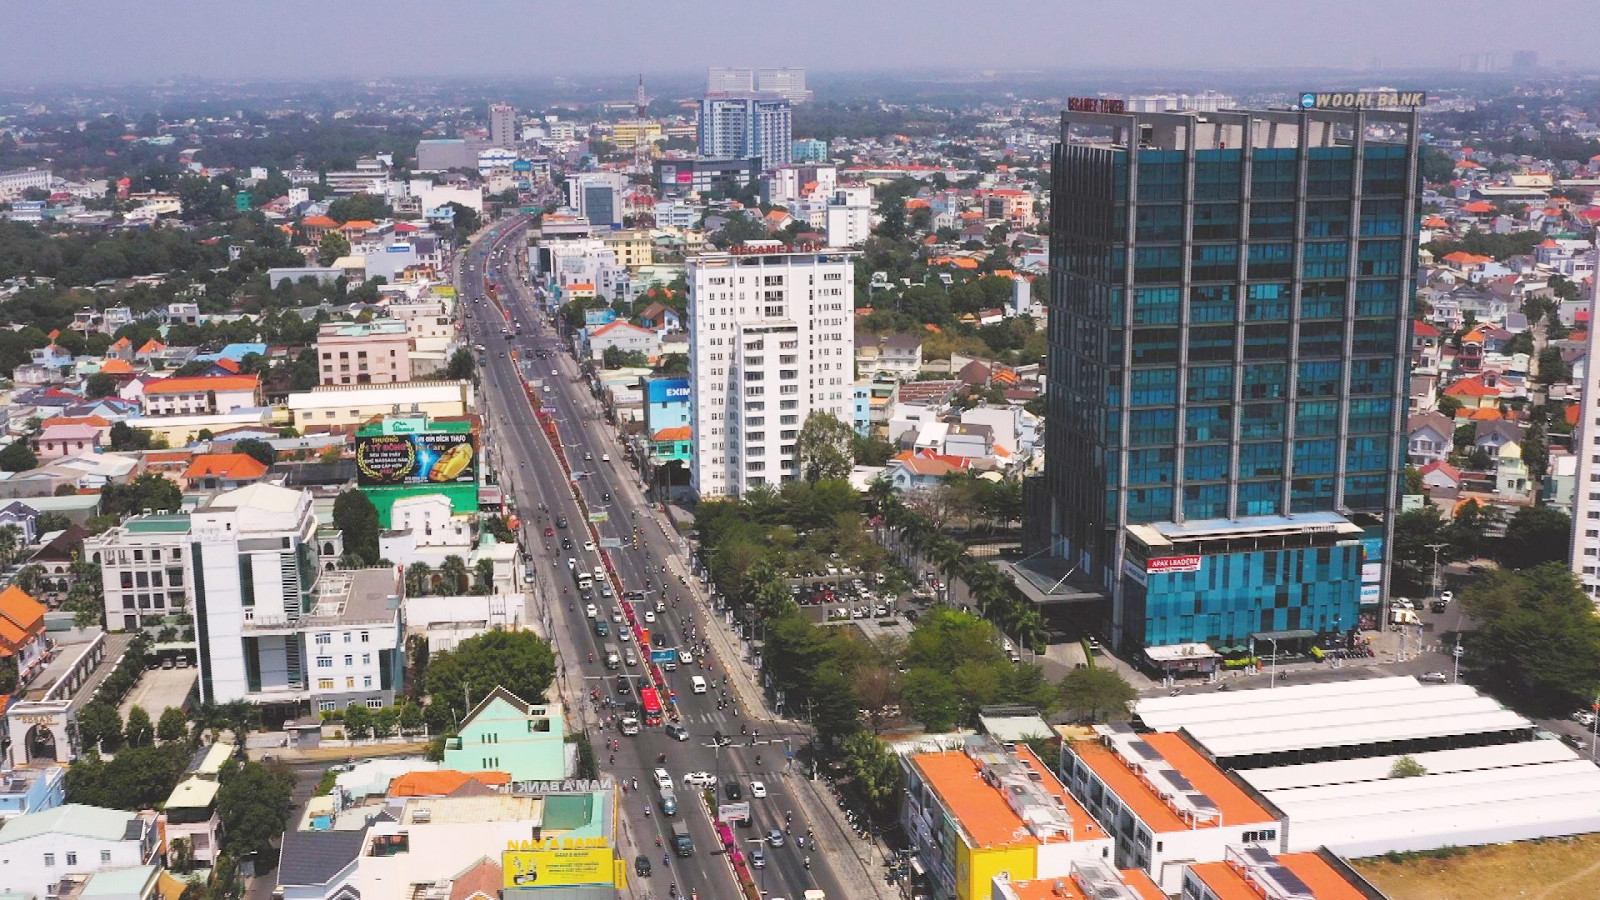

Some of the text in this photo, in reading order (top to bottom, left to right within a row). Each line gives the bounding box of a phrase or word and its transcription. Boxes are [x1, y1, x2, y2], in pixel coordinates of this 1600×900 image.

[1316, 92, 1423, 107] WOORI BANK
[729, 244, 793, 255] BECAMEX
[1152, 557, 1198, 568] APAX LEADERS
[507, 839, 546, 851] NAM
[563, 837, 609, 849] BANK
